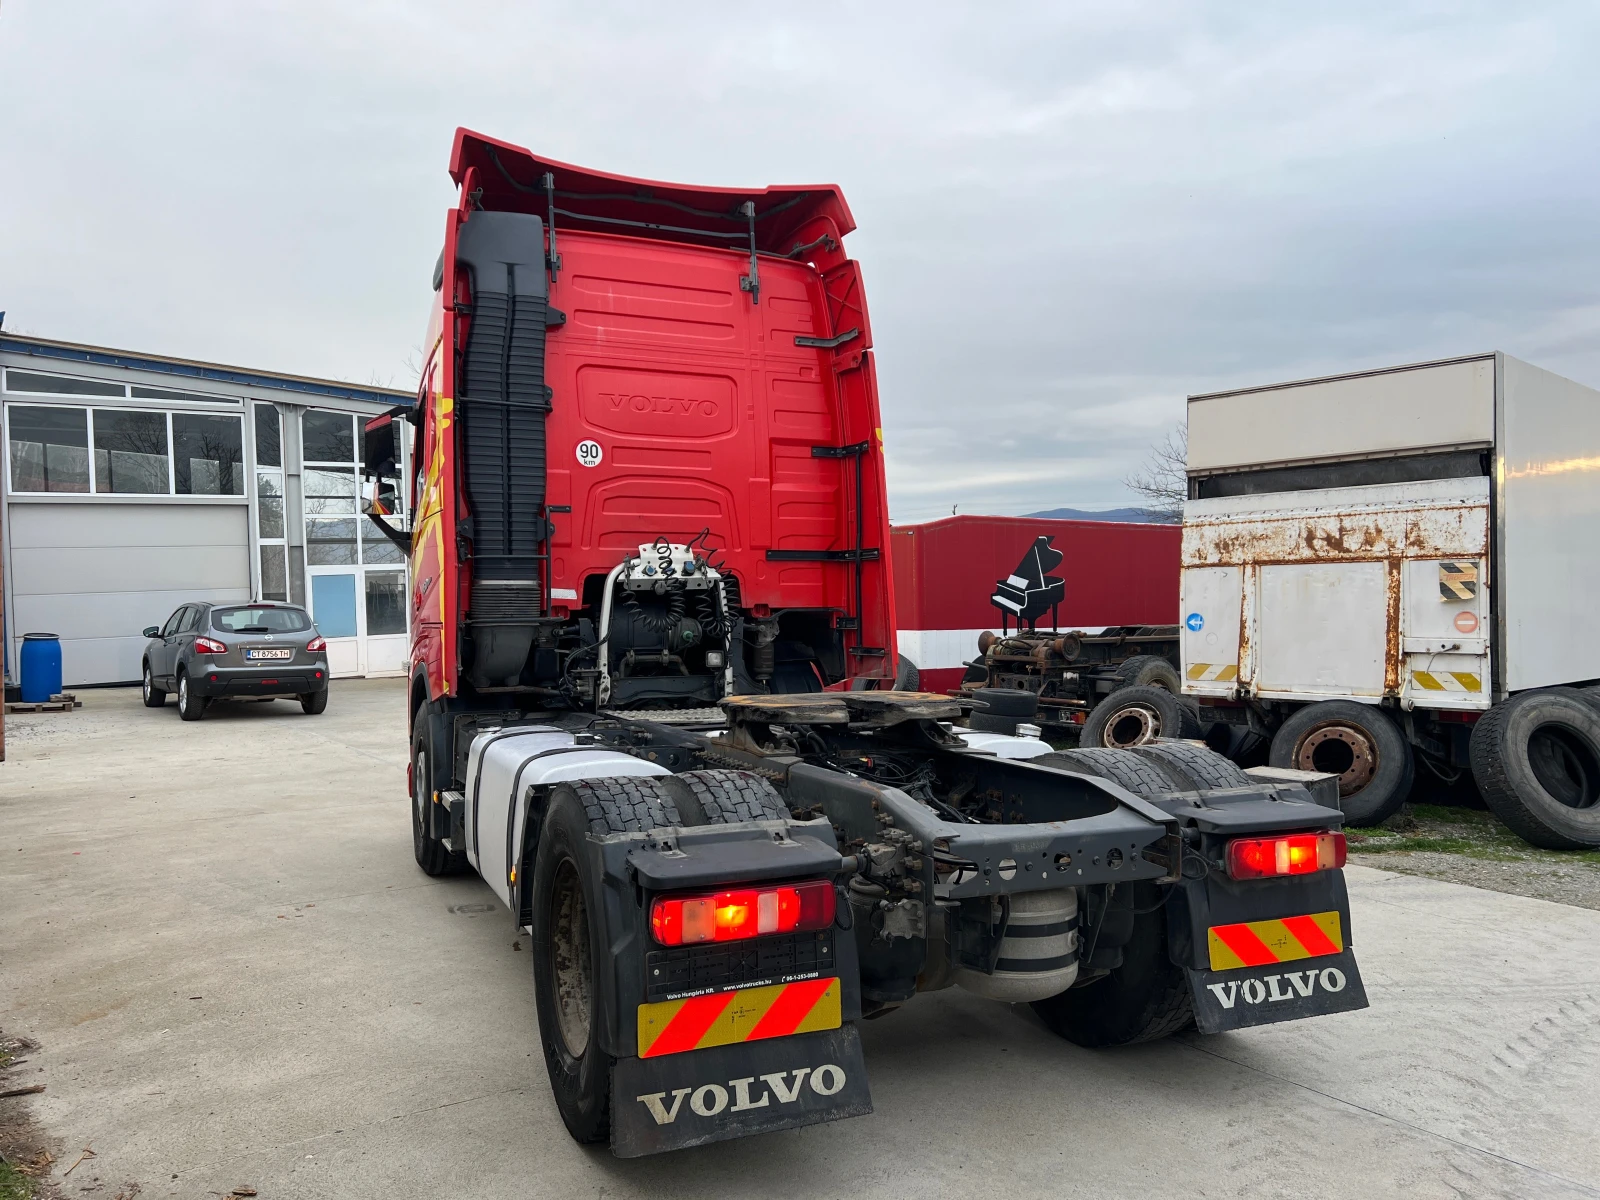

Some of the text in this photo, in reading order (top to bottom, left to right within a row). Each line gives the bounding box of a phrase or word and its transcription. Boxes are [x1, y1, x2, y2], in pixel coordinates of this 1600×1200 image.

[598, 392, 719, 417] VOLVO
[580, 443, 598, 459] 90
[722, 979, 772, 991] www.volvotrucks.hu
[1206, 967, 1347, 1009] VOLVO
[637, 1064, 846, 1125] VOLVO
